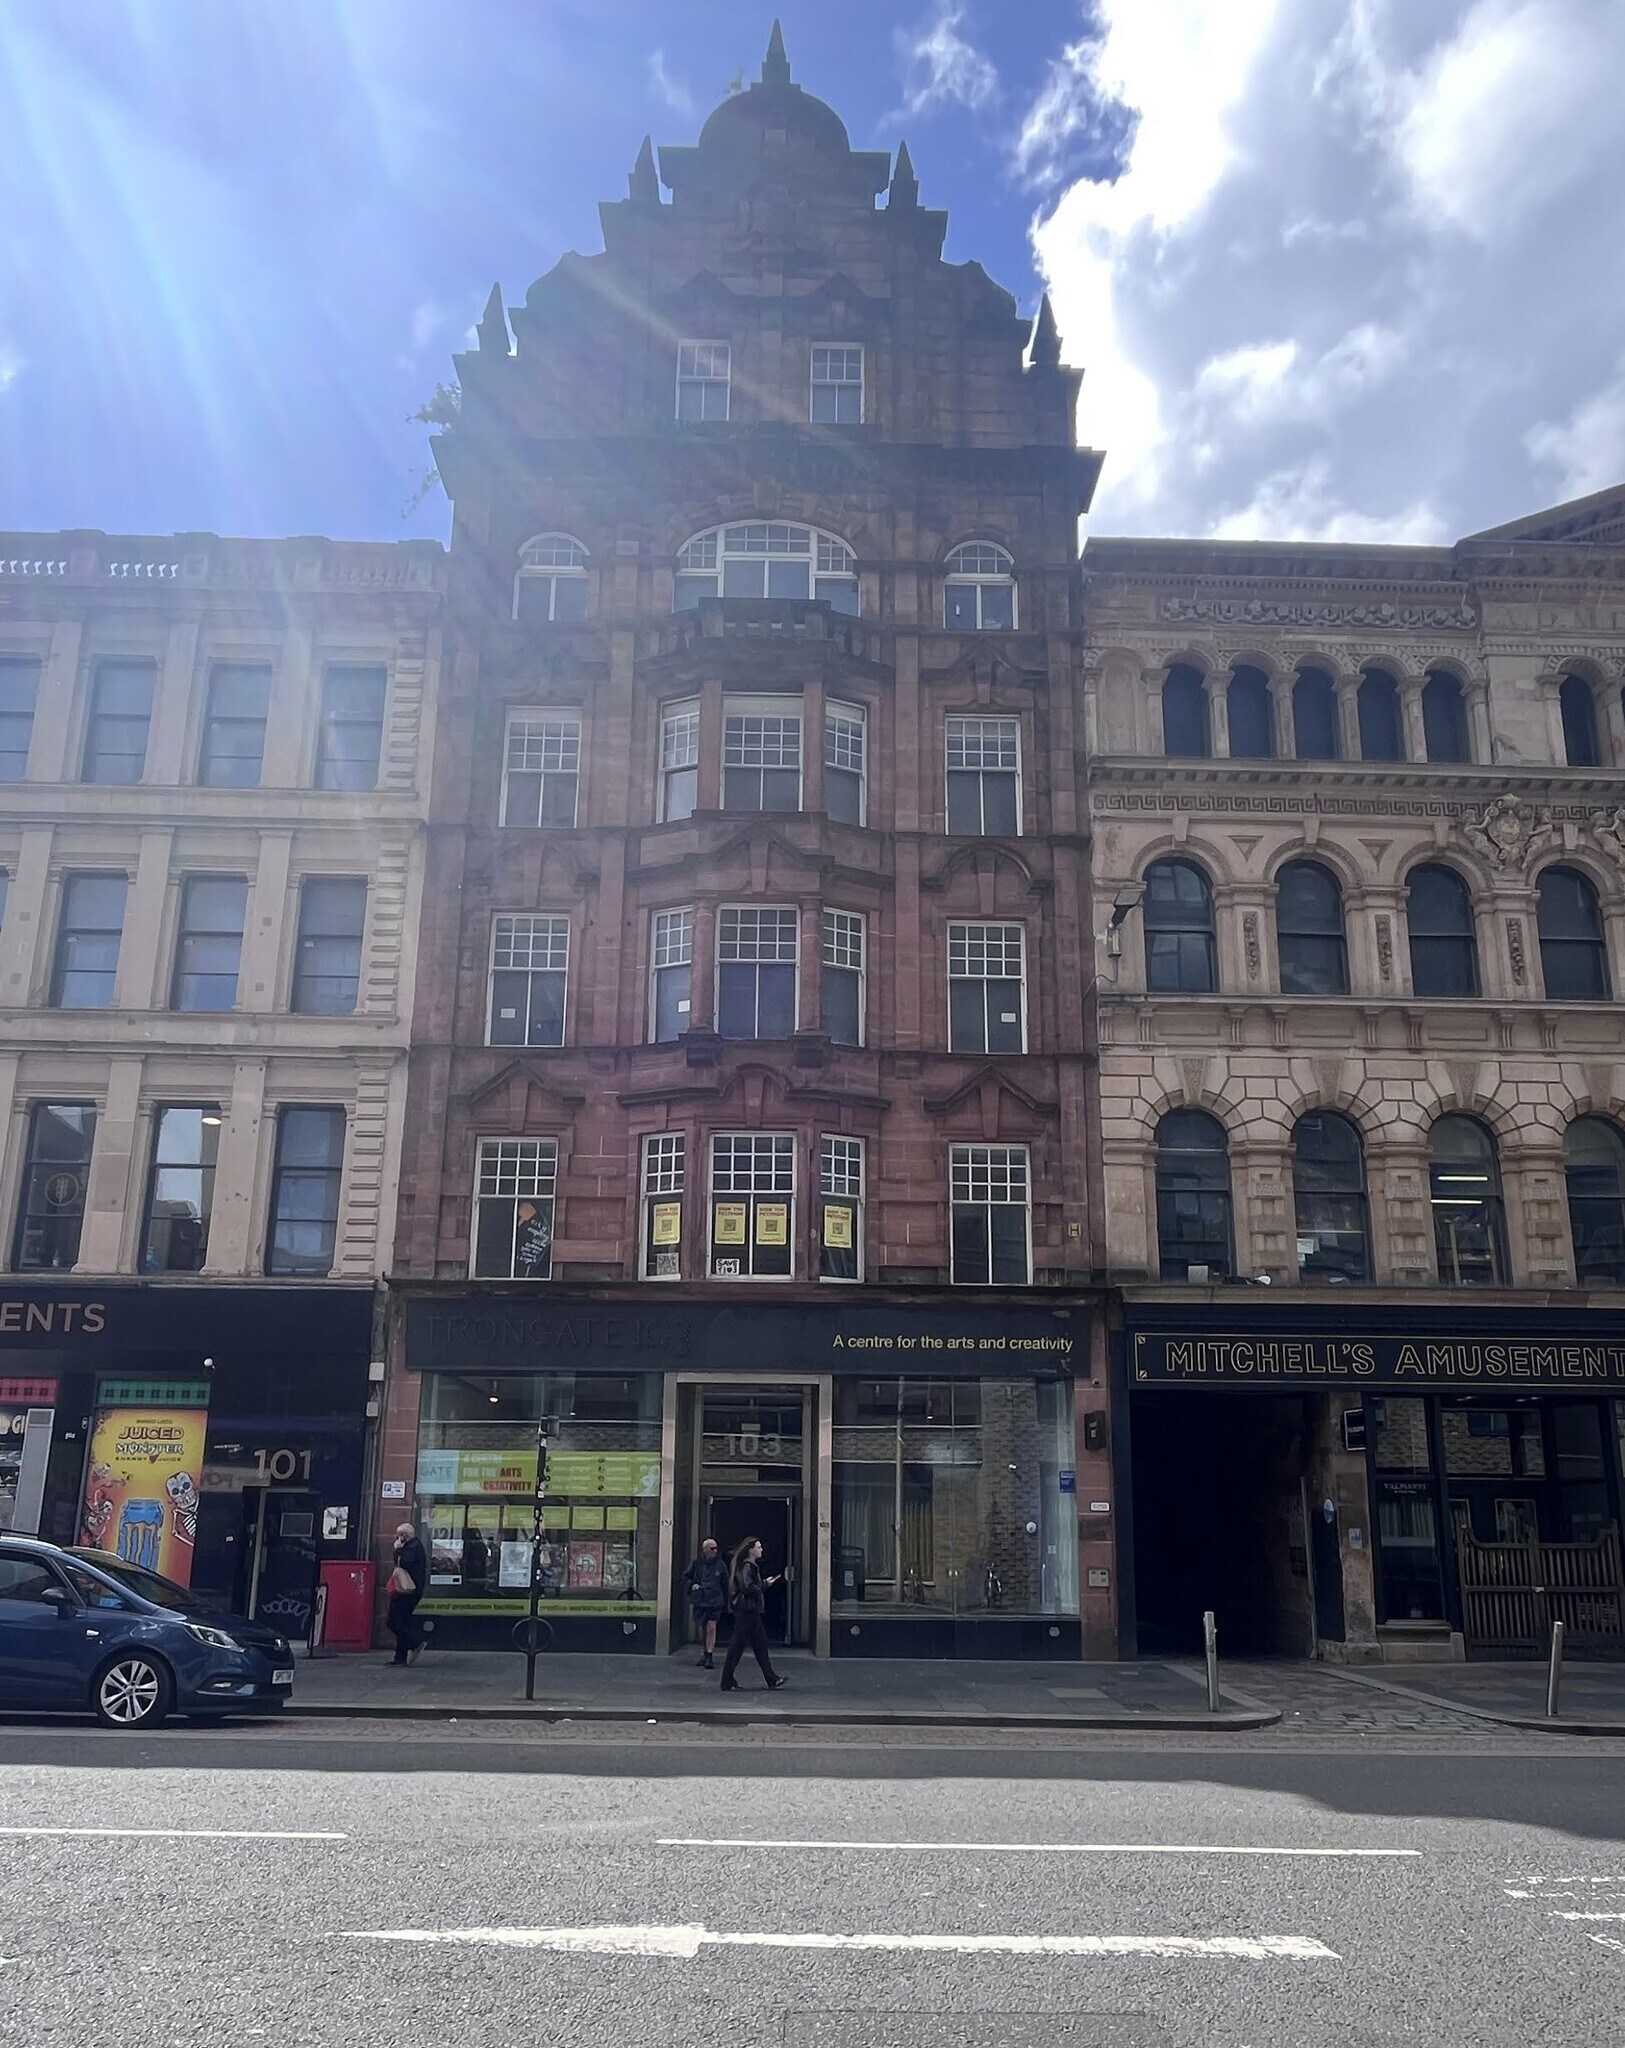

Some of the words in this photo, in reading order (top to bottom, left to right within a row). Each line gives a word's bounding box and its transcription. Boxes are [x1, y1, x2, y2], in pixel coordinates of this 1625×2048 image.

[1070, 1224, 1080, 1236] H
[717, 1259, 738, 1267] SAVE
[424, 1316, 622, 1345] TRONGATE
[631, 1317, 692, 1358] 103
[832, 1335, 844, 1347] A
[848, 1336, 893, 1348] centre
[896, 1336, 916, 1348] for
[920, 1336, 943, 1348] the
[946, 1337, 974, 1349] arts
[979, 1337, 1006, 1349] and
[1009, 1337, 1073, 1353] creativity
[1165, 1341, 1375, 1375] MITCHELL'S
[1394, 1345, 1625, 1377] AMUSEMENT
[118, 1425, 184, 1440] JUICED
[115, 1441, 184, 1456] MONSTER
[724, 1433, 782, 1456] 103
[253, 1448, 312, 1480] 101
[500, 1467, 522, 1477] ARTS
[483, 1480, 532, 1491] CREATIVITY
